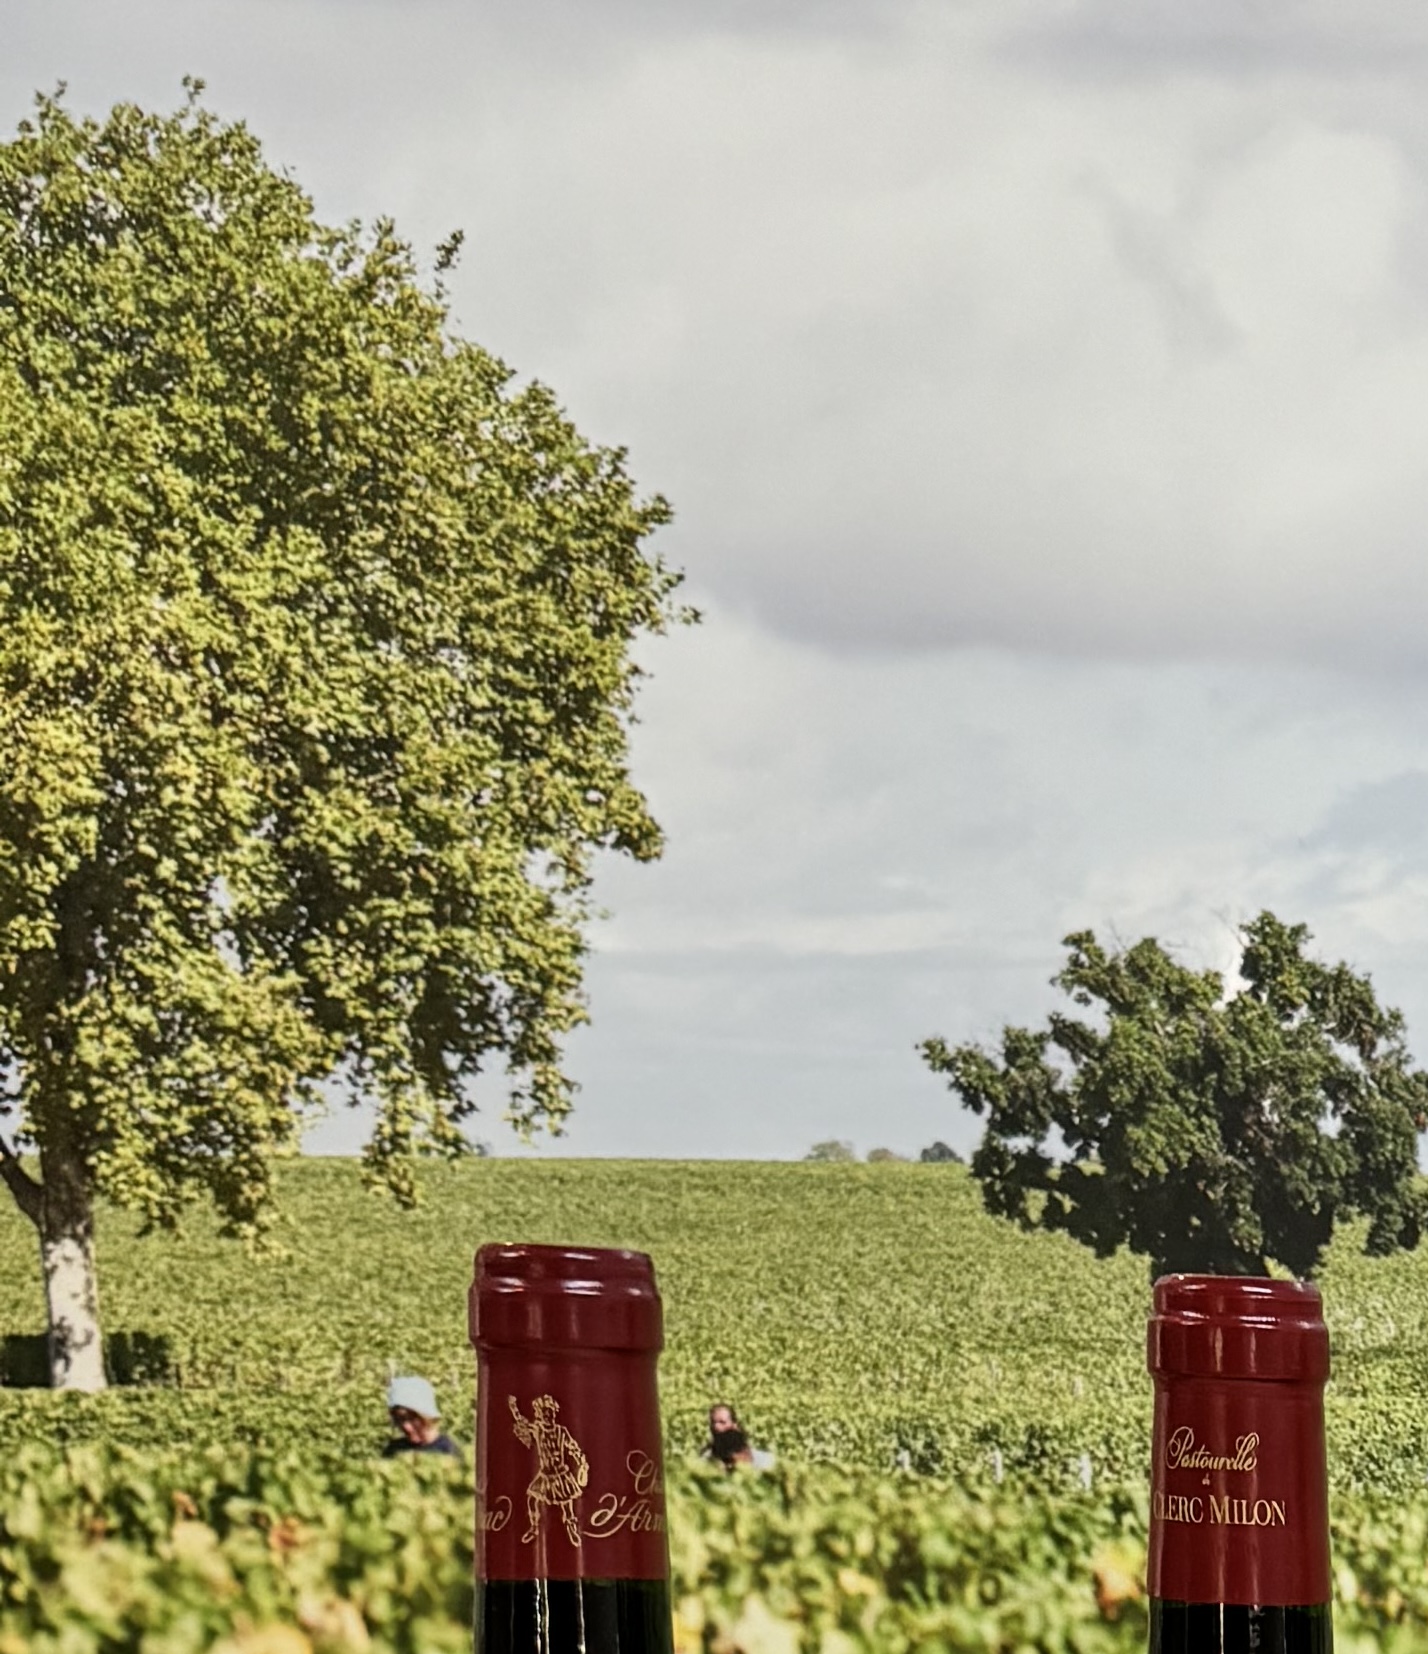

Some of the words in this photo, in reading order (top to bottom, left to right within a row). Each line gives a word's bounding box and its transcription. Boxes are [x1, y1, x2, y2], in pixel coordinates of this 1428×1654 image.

[1165, 1426, 1260, 1472] Pastourelle
[1153, 1490, 1204, 1523] CLERC
[1209, 1494, 1286, 1526] MILON
